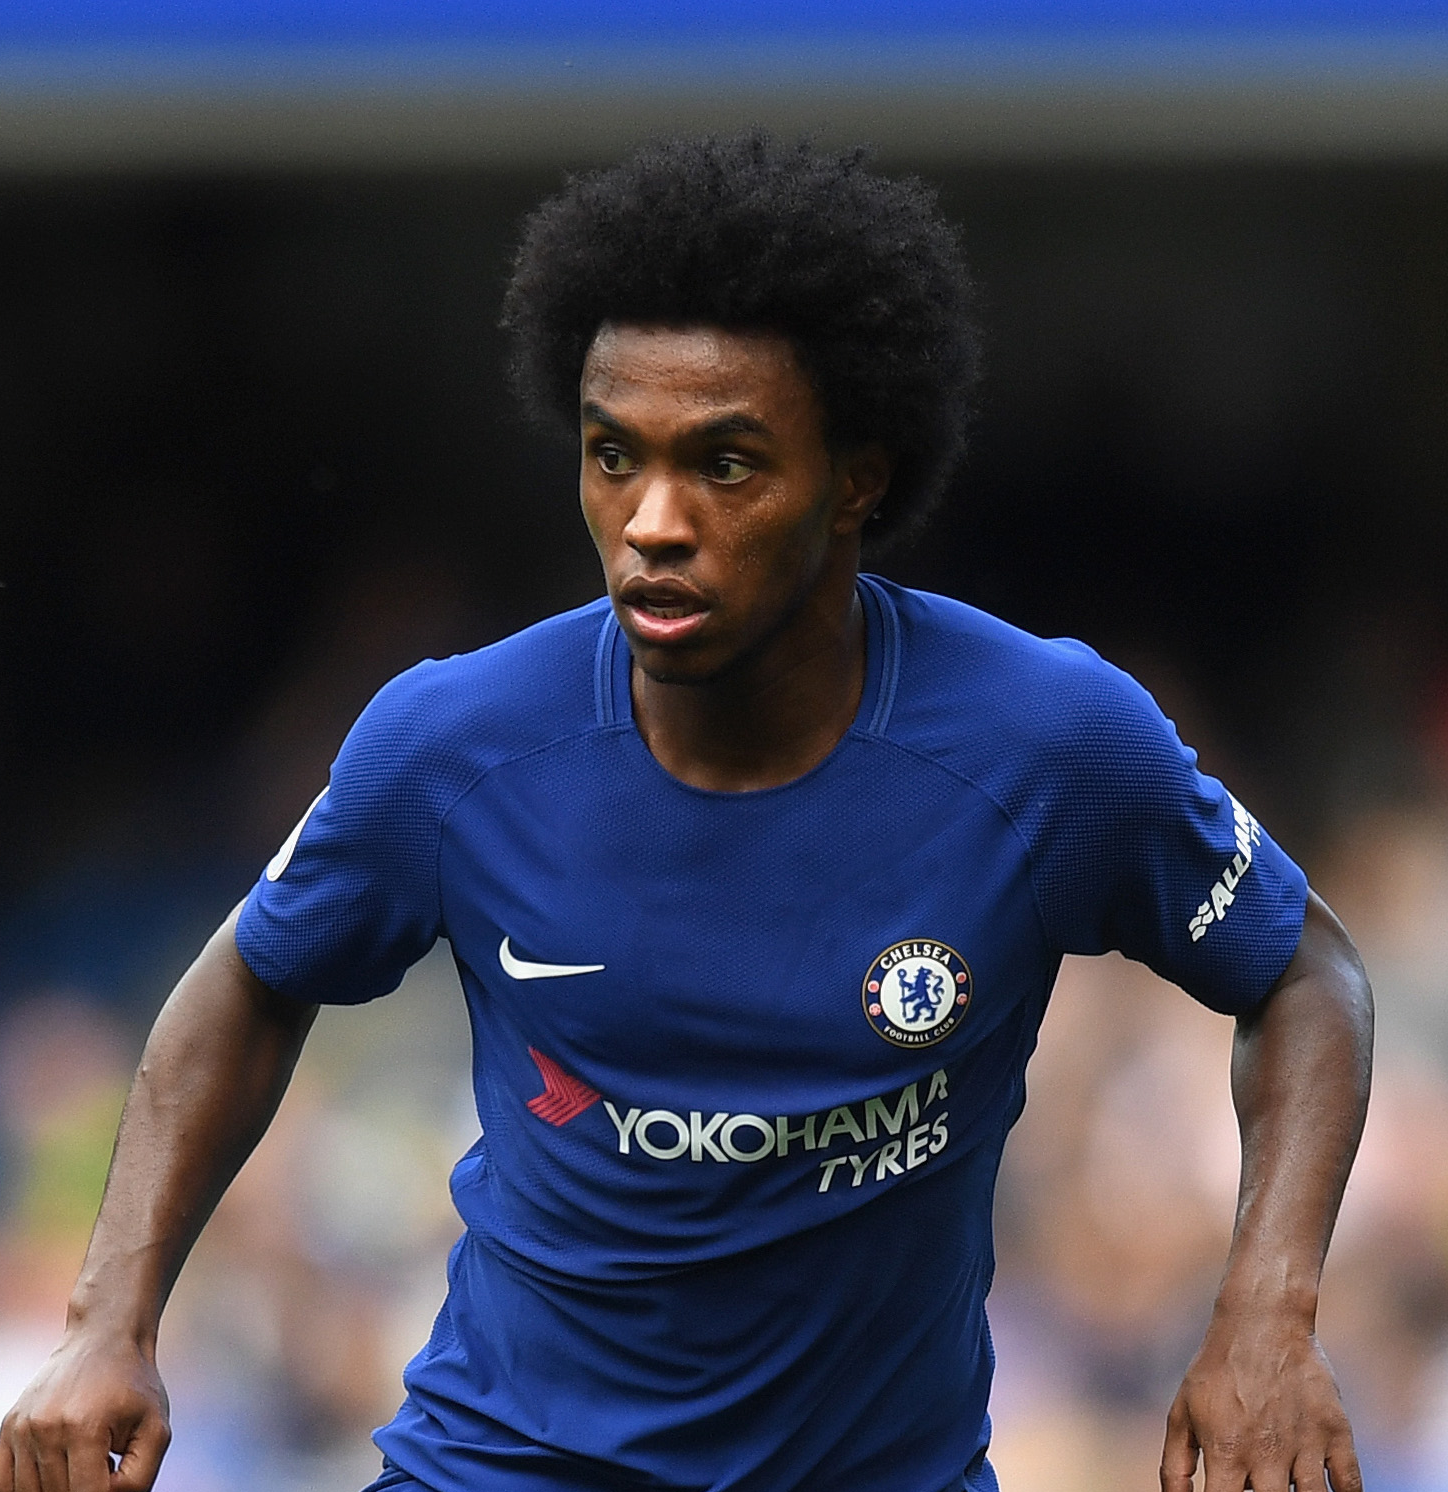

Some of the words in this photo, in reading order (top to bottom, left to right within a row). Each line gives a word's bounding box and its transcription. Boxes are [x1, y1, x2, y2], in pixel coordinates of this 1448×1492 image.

[880, 943, 952, 970] CHELSEA
[883, 1024, 930, 1042] FOOTBALL
[934, 1017, 955, 1036] CLUB
[603, 1068, 949, 1163] YOKOHAMA
[818, 1111, 949, 1193] TYRES
